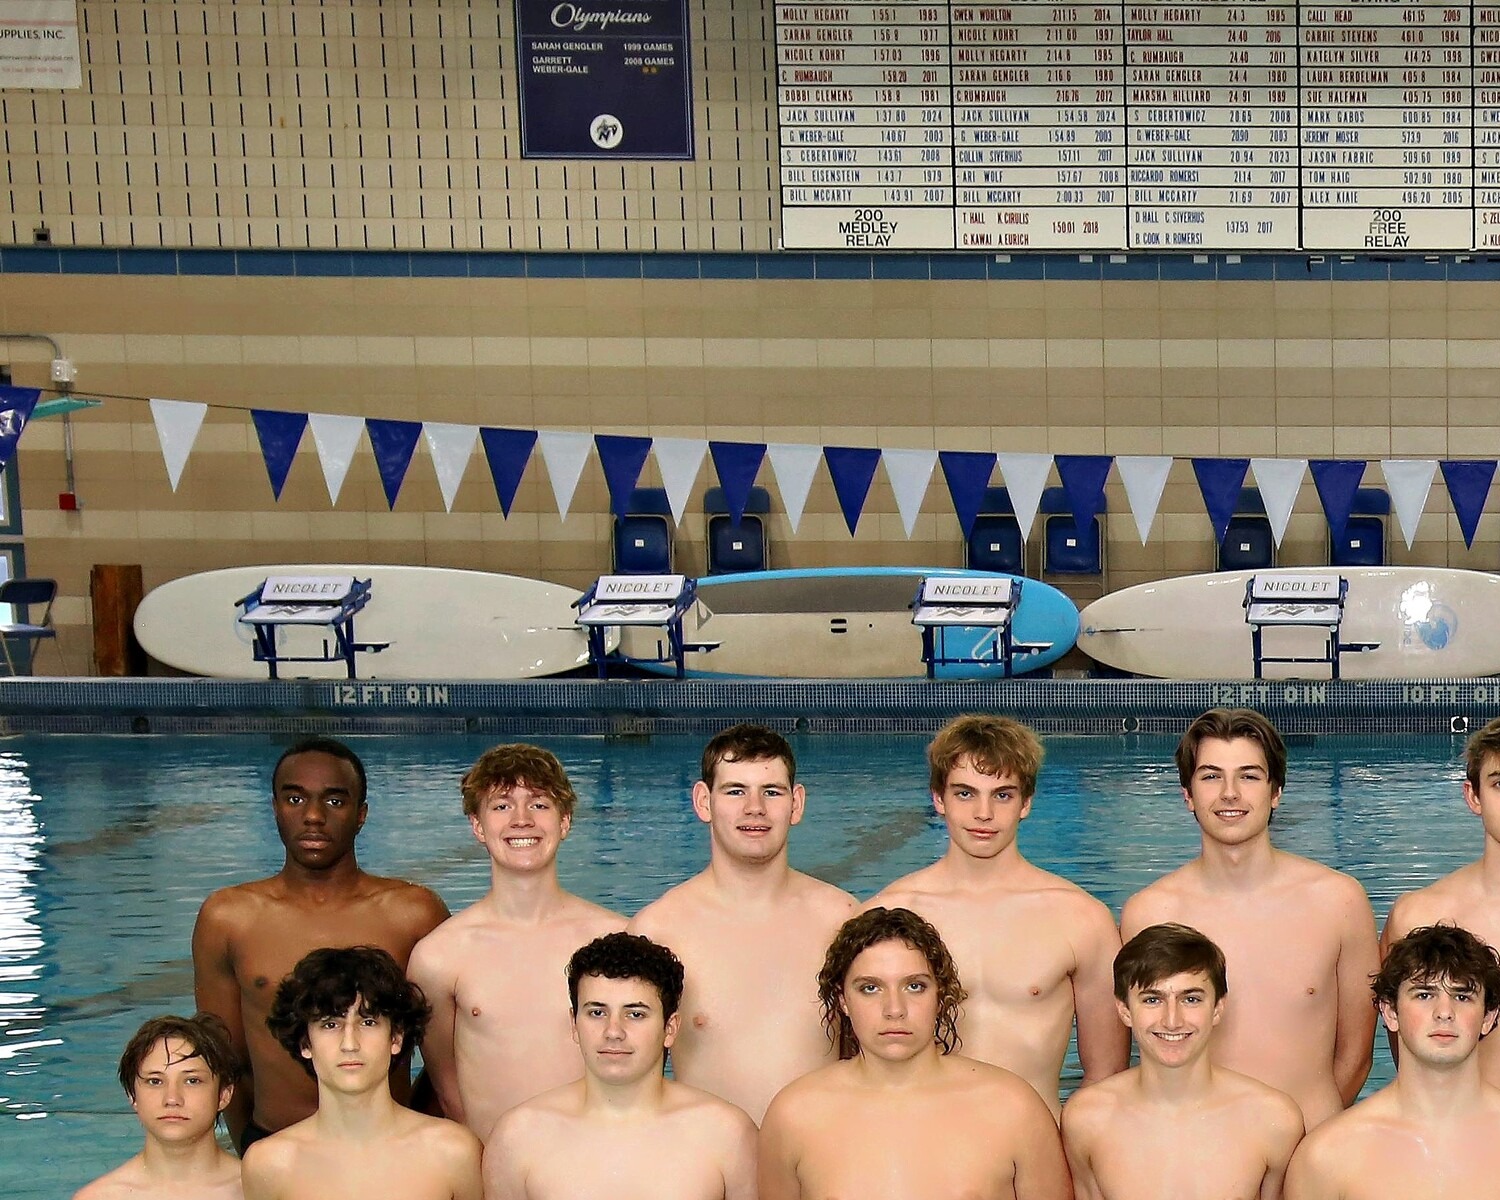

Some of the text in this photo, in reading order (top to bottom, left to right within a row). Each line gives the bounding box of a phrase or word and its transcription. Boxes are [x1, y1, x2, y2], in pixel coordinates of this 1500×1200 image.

[551, 3, 651, 31] Olympians
[783, 9, 937, 21] MOLLY HEGARTY 1983
[44, 30, 65, 39] INC.
[959, 29, 986, 41] NICOLE
[993, 29, 1018, 41] KOHRT
[959, 49, 1112, 61] MOLLY HEGARTY 1985
[1307, 51, 1461, 62] KATELYN SILVER 1998
[1133, 70, 1286, 82] SARAH GENGLER 1980
[786, 90, 938, 101] BOBBI CLEMENS 1981
[1133, 90, 1285, 102] MARSHA HILLIARD 1989
[1308, 111, 1460, 123] MARK GABOS 1984
[1135, 150, 1289, 163] JACK SULLIVAN 2023
[1309, 151, 1373, 163] JASON FABRIC
[963, 171, 1118, 182] ARI WOLF 2008
[790, 190, 943, 201] BILL MCCARTY 2007
[1310, 192, 1462, 203] ALEX KIAIE 2005
[855, 210, 883, 223] 200
[1374, 210, 1401, 221] 200
[839, 222, 897, 233] MEDLEY
[1370, 223, 1406, 234] FREE
[846, 235, 891, 246] RELAY
[1365, 236, 1409, 247] RELAY
[273, 584, 341, 593] NICOLET
[606, 584, 673, 592] NICOLET
[935, 586, 1002, 594] NICOLET
[1265, 583, 1330, 591] NICOLET
